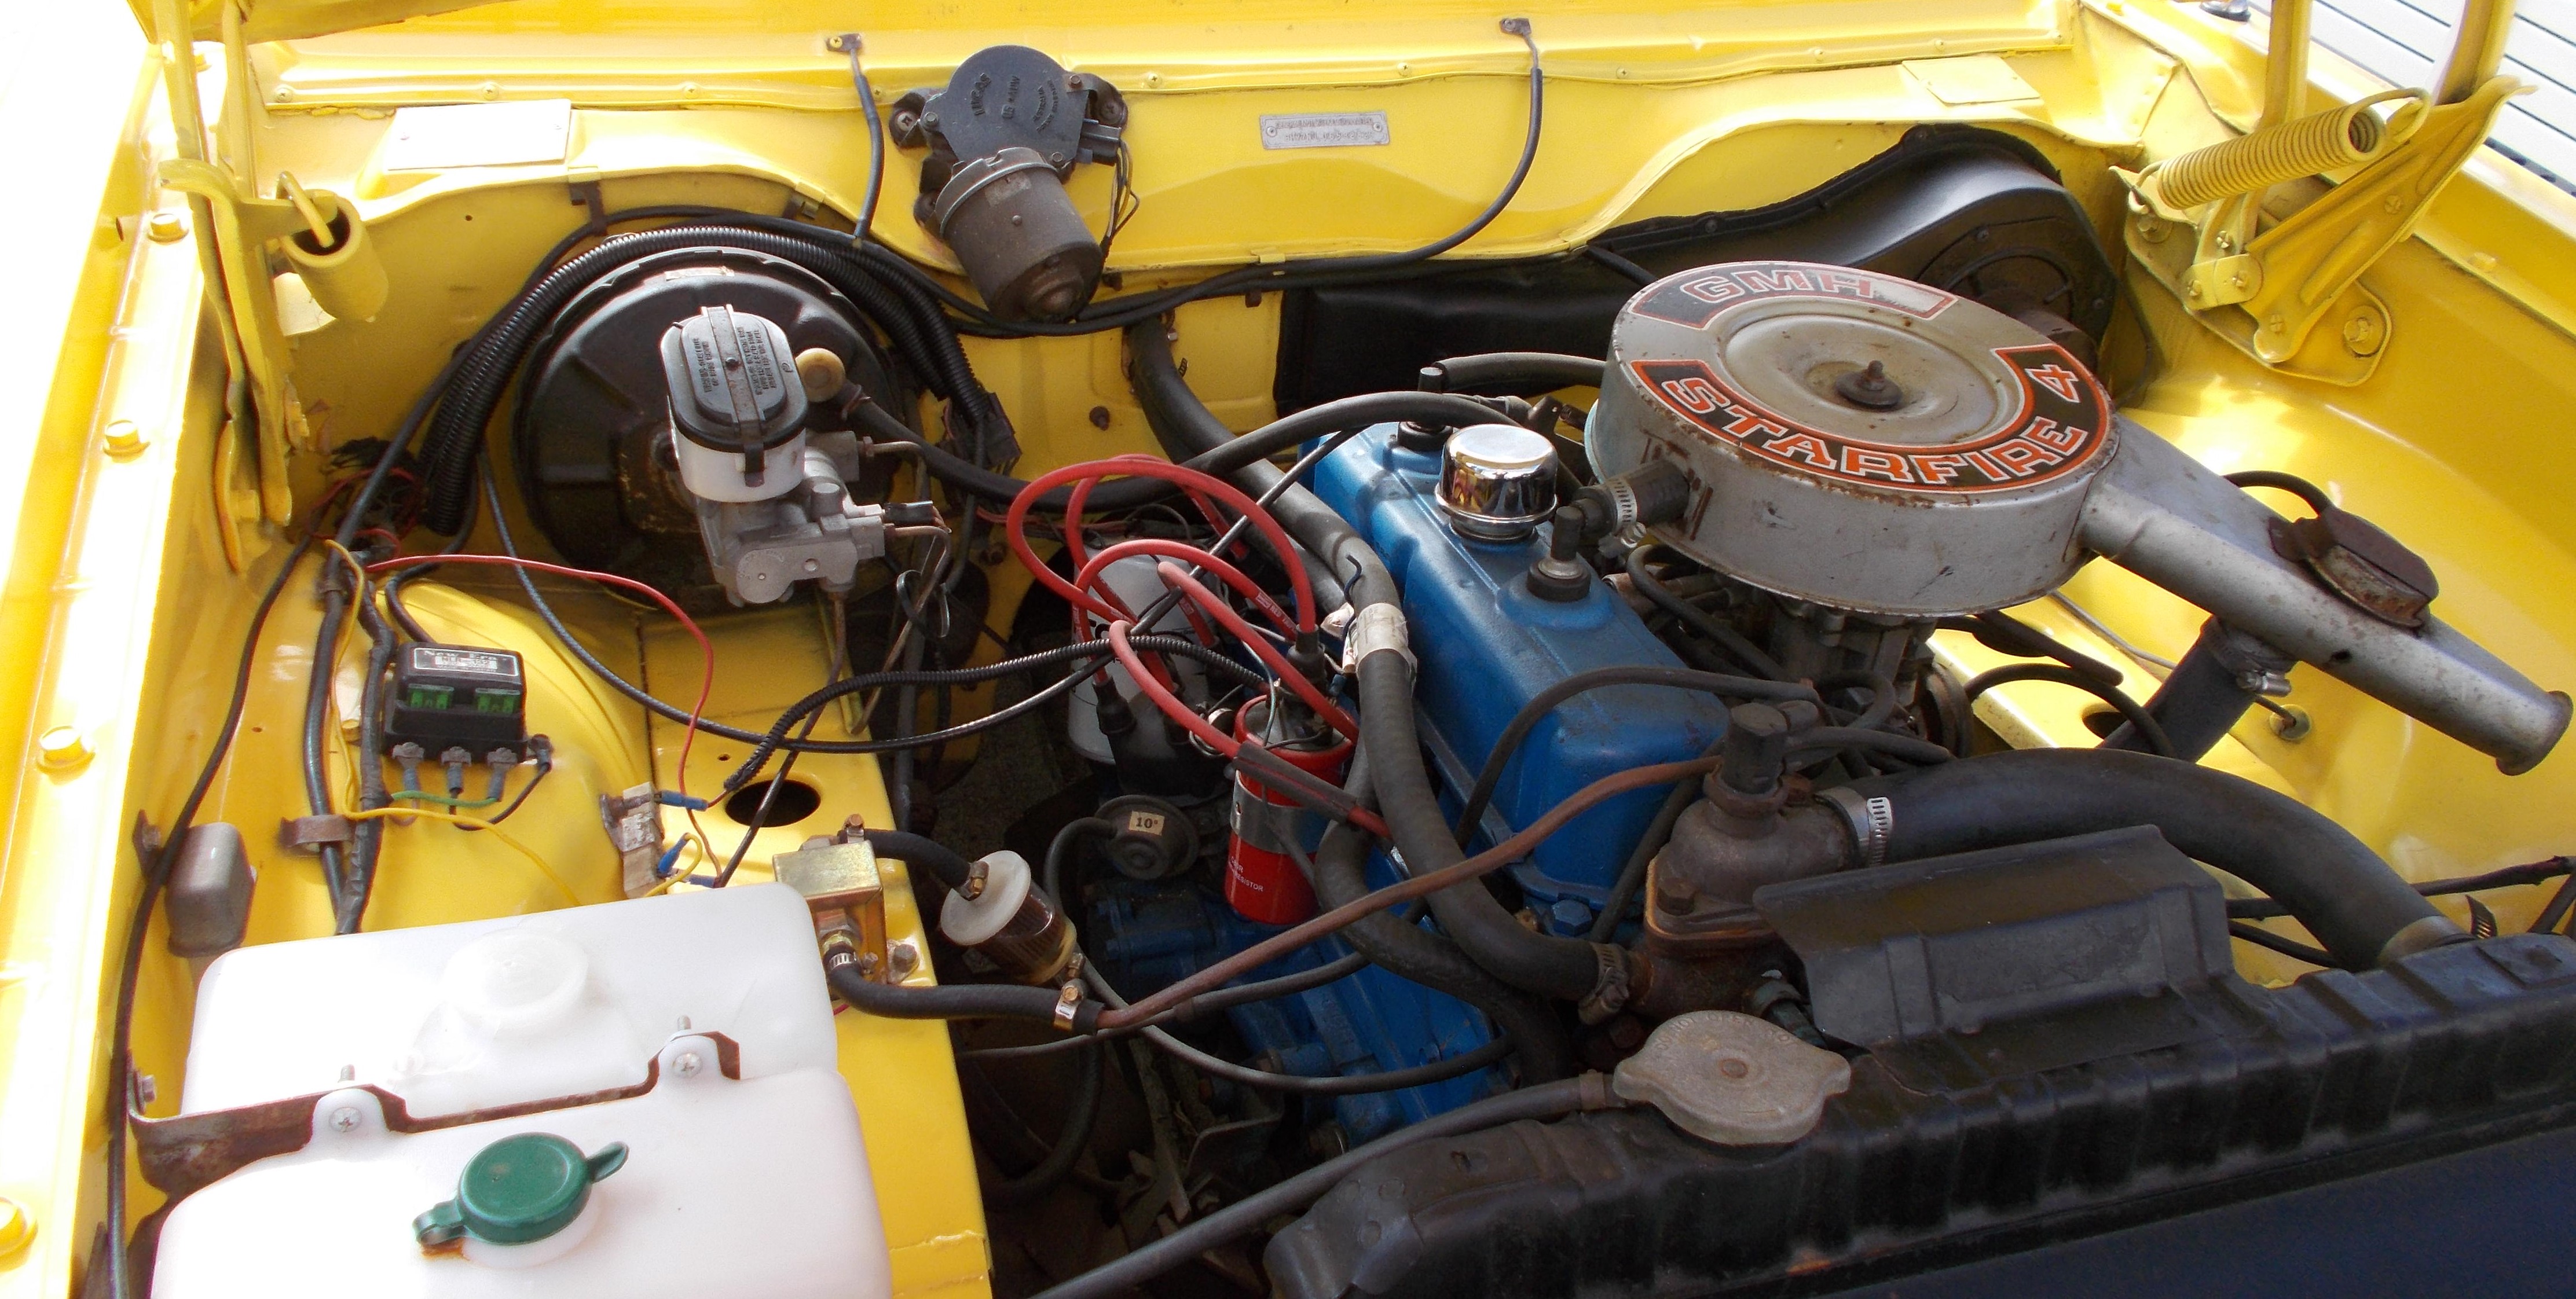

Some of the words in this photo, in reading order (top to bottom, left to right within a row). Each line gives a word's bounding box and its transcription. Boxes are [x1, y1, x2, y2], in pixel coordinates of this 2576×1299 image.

[970, 72, 992, 116] LUCAS
[1680, 270, 1874, 303] GMH
[1662, 377, 2088, 484] STARFIRE
[2025, 364, 2082, 403] 4
[1136, 817, 1159, 829] 10°
